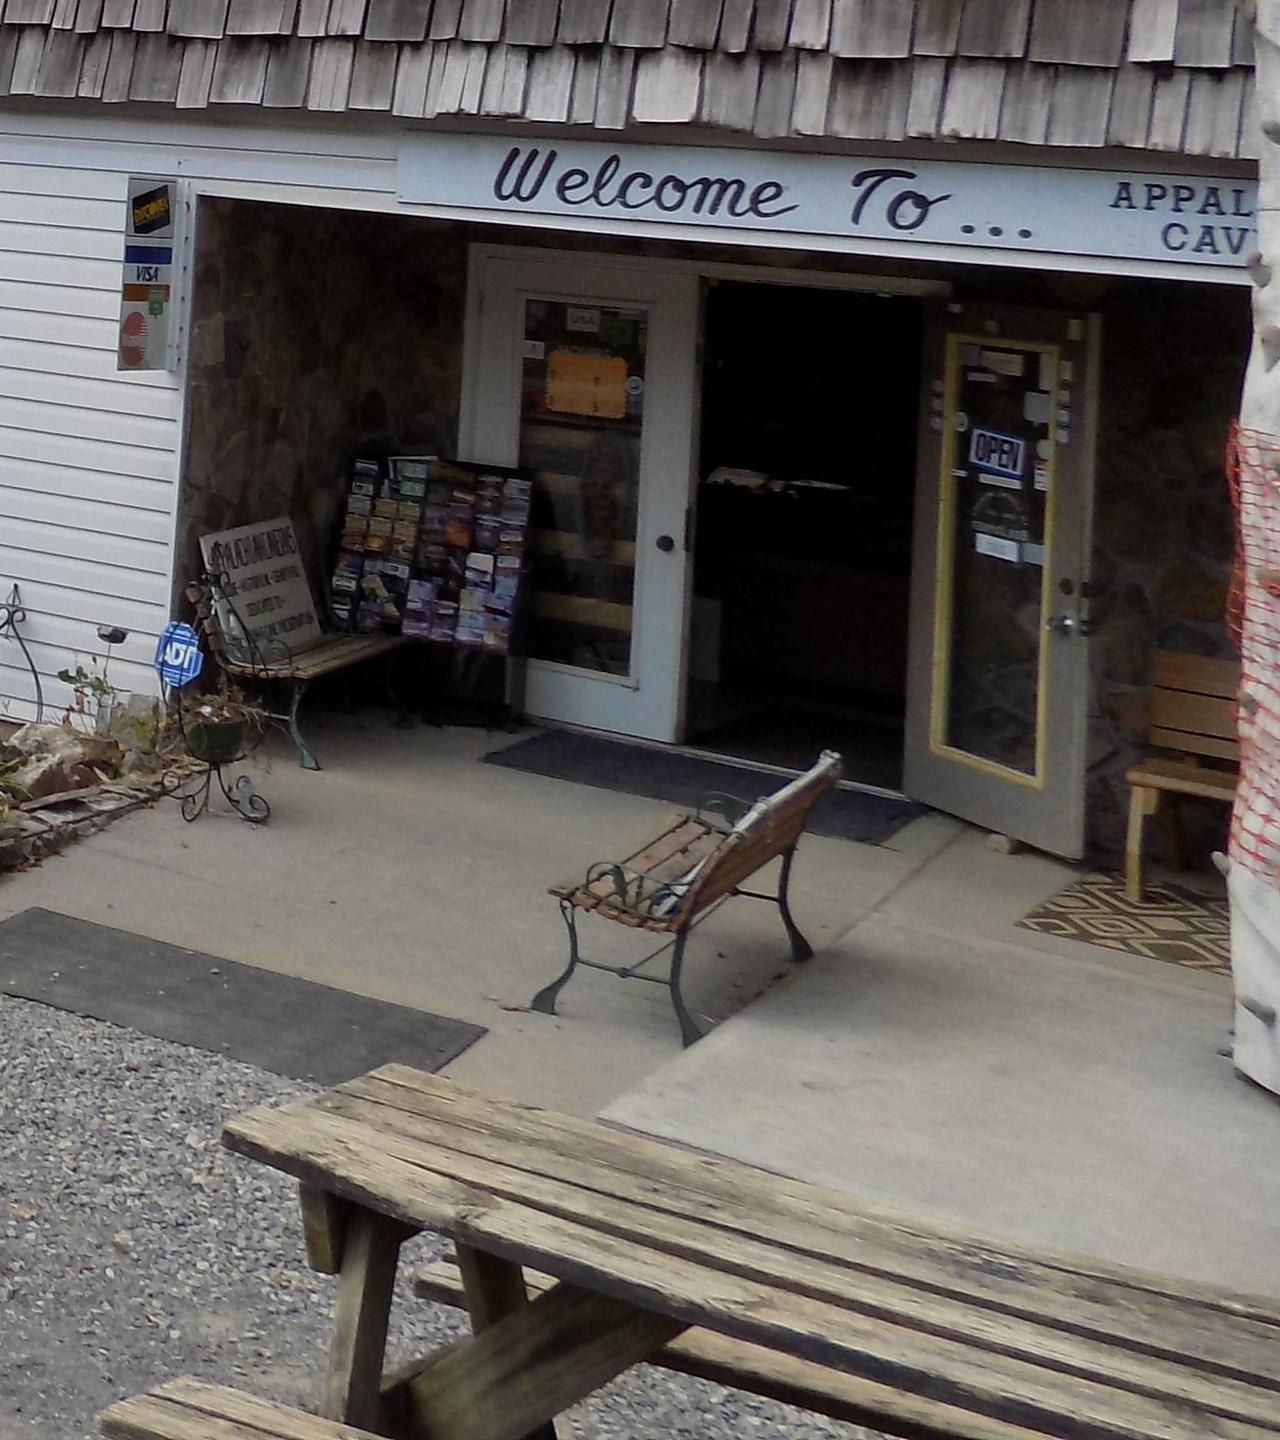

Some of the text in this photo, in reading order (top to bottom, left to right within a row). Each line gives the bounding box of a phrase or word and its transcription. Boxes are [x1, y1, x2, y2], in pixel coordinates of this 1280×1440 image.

[493, 147, 801, 218] Welcome
[1160, 221, 1258, 256] CAV
[136, 266, 160, 282] VISA
[975, 432, 1022, 473] OPEN
[158, 642, 197, 669] ADT
